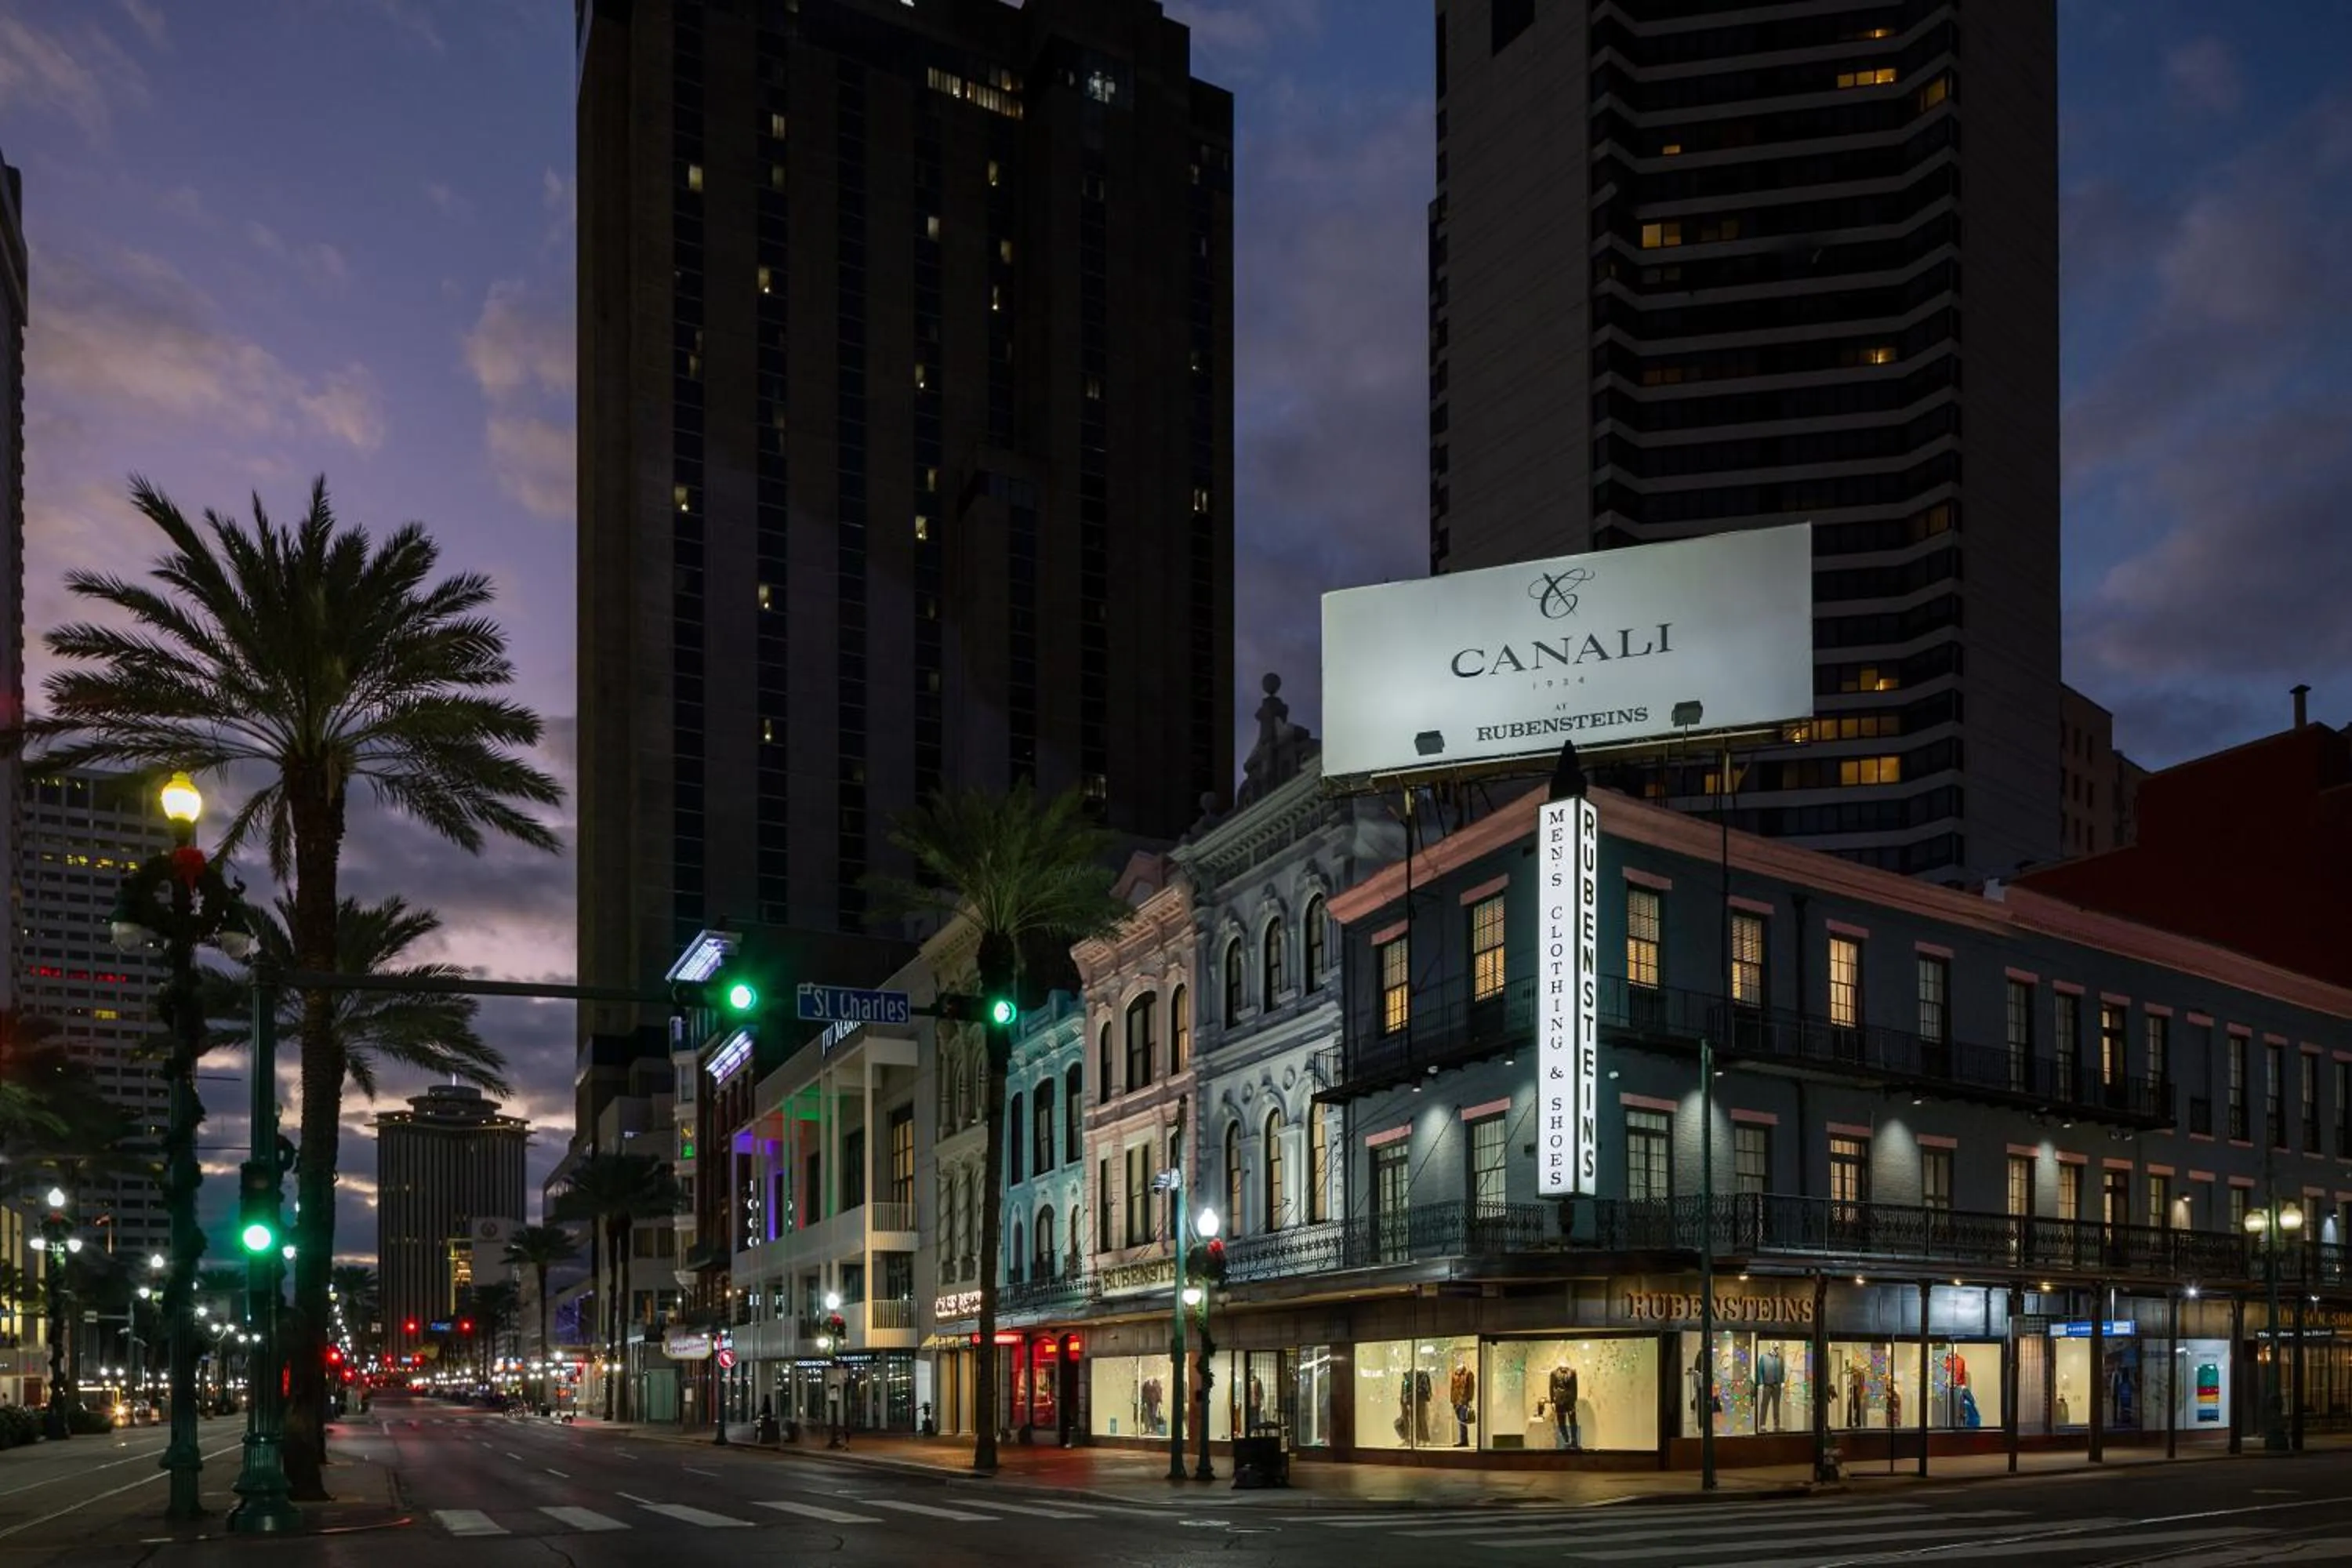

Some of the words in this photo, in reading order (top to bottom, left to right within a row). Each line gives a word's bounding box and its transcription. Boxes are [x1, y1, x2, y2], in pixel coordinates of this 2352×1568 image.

[1451, 623, 1674, 678] CANALI
[1476, 706, 1649, 742] RUBENSTEINS
[1548, 808, 1565, 887] MEN'S
[1550, 906, 1563, 1050] CLOTHING
[1583, 809, 1595, 1178] RUBENSTEINS
[840, 991, 906, 1022] Charles
[1550, 1066, 1563, 1080] &
[1550, 1097, 1563, 1186] SHOES
[1628, 1292, 1813, 1323] RUBENSTEINS
